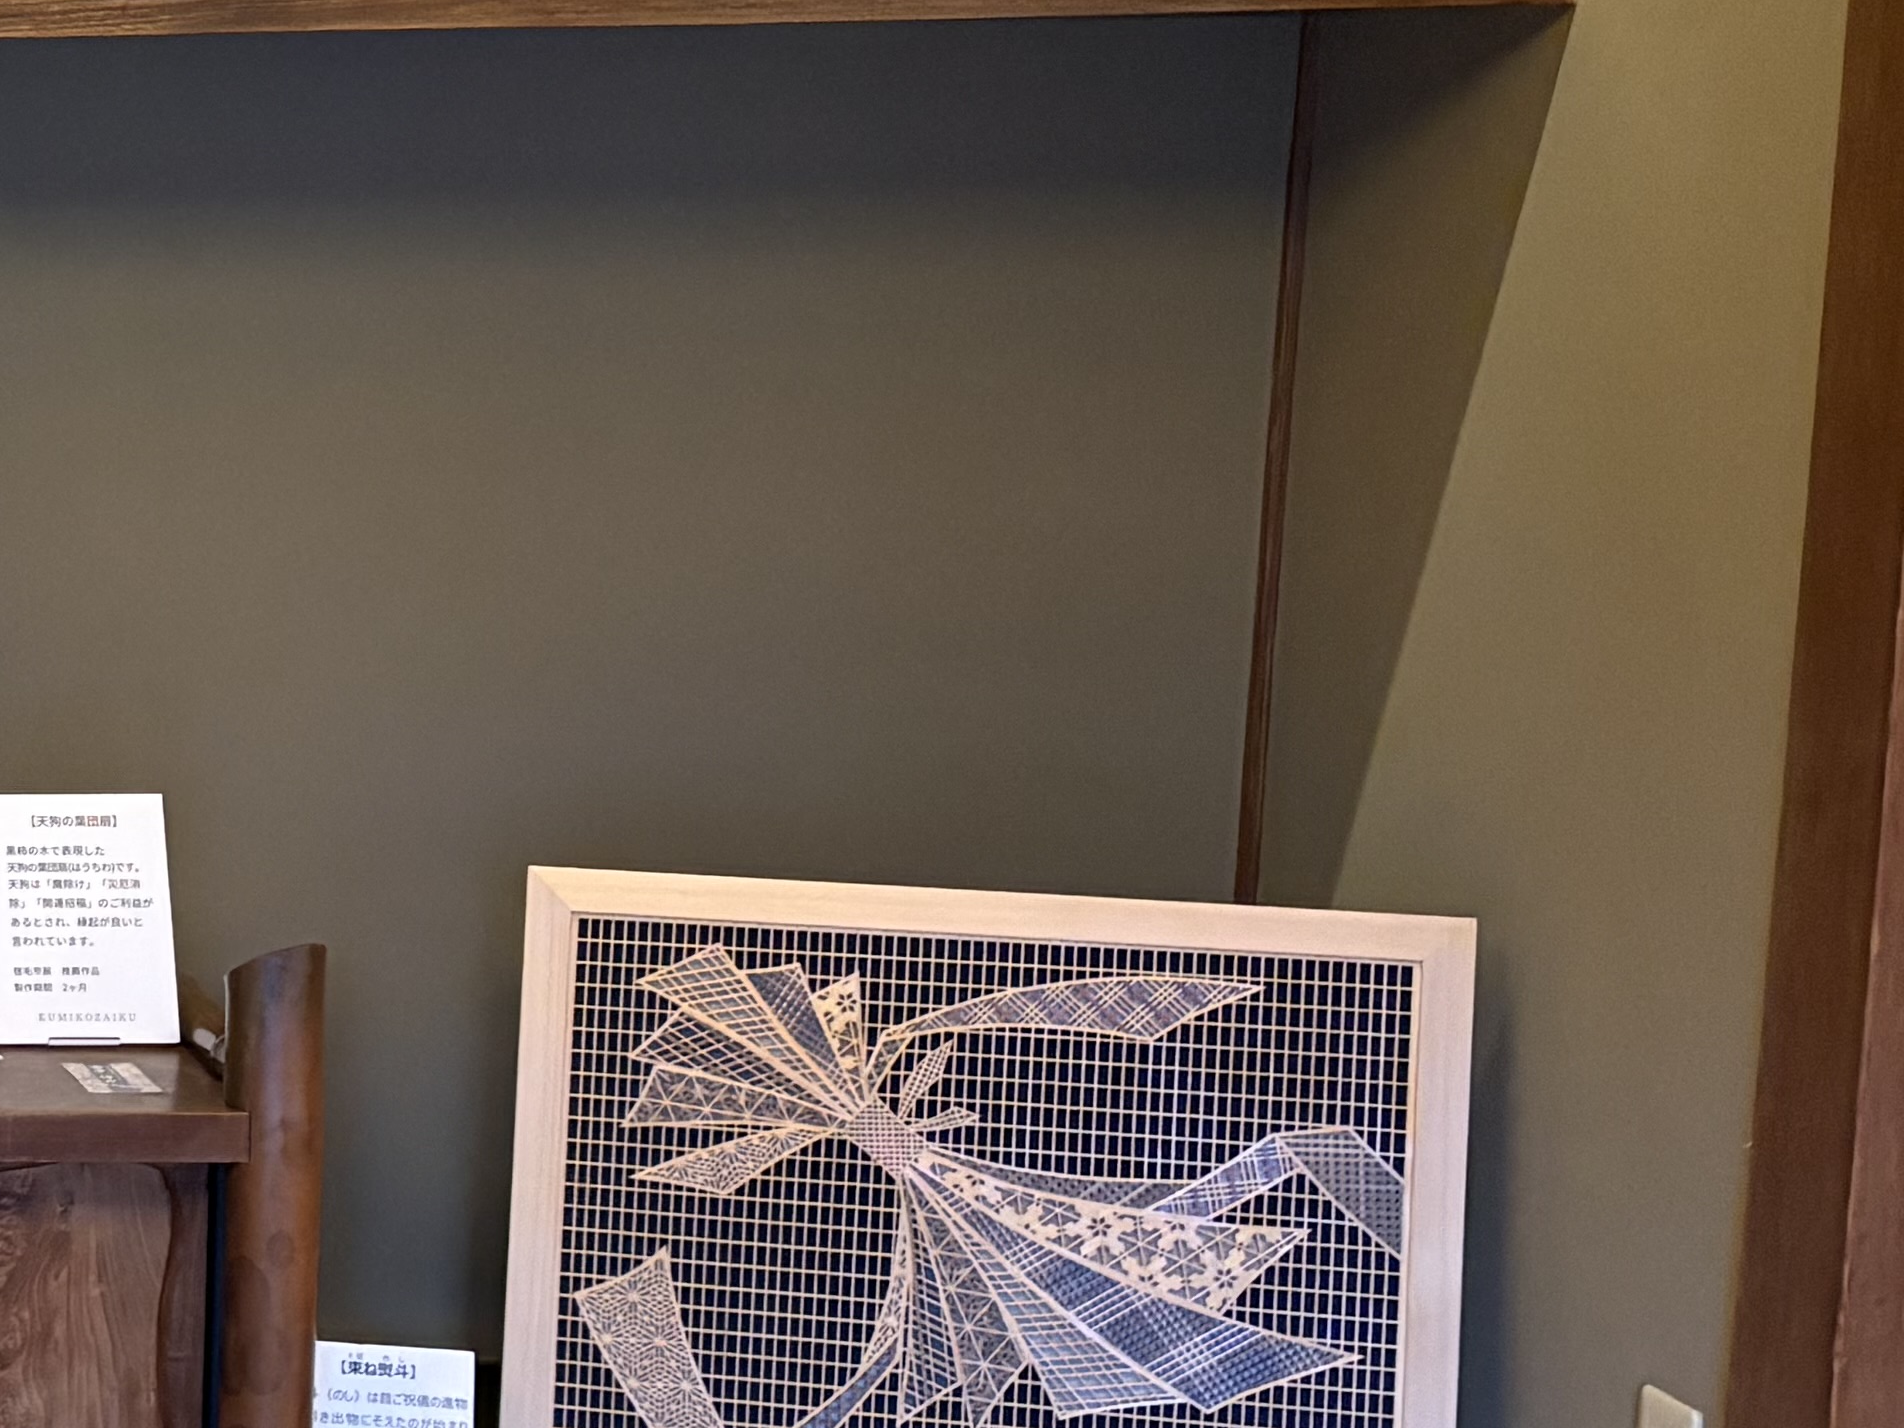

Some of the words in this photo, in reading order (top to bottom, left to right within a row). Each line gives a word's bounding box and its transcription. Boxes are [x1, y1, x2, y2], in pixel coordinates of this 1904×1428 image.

[12, 936, 95, 947] 言われています。
[38, 1013, 136, 1022] KUMIKOZAIKU
